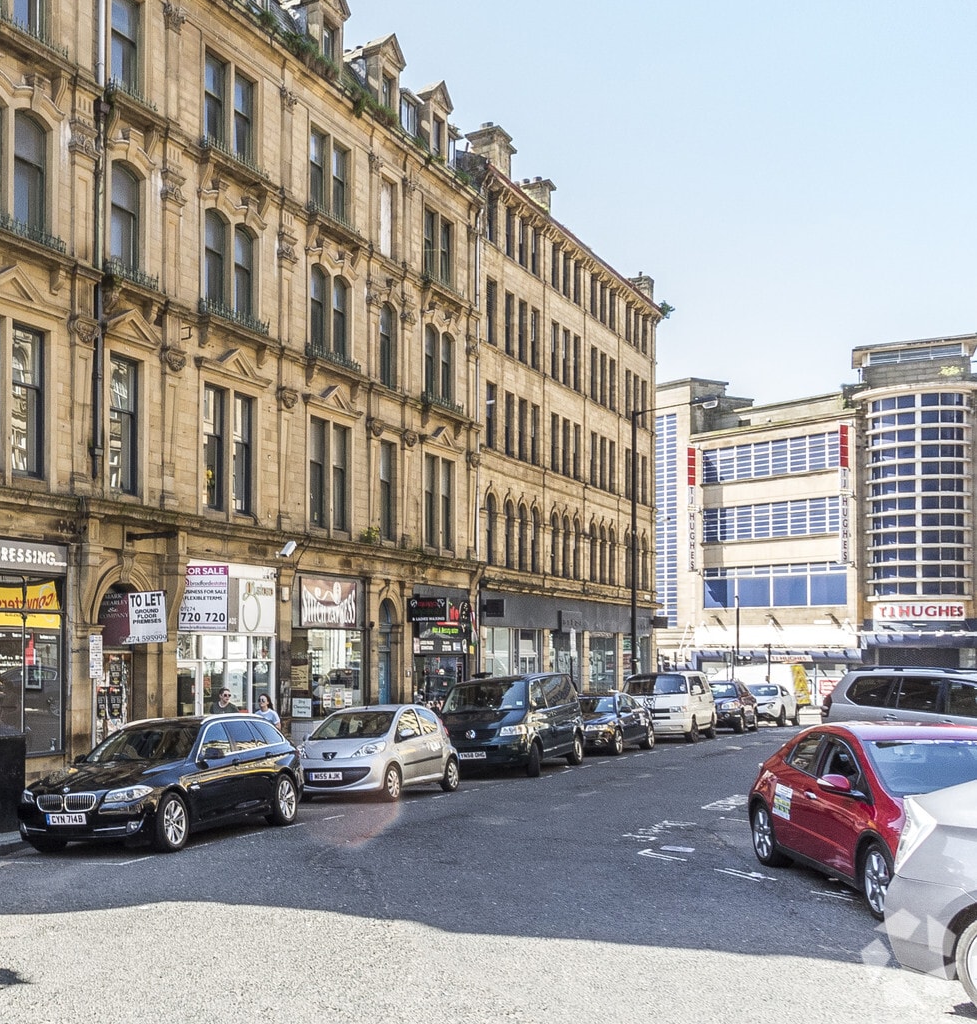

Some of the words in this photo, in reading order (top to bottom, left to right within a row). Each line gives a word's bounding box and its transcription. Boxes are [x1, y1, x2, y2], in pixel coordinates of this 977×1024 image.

[186, 567, 201, 575] OR
[202, 567, 225, 575] SALE
[130, 593, 142, 607] TO
[144, 593, 162, 606] LET
[898, 605, 964, 617] HUGHES
[180, 612, 201, 622] 720
[205, 612, 226, 622] 720
